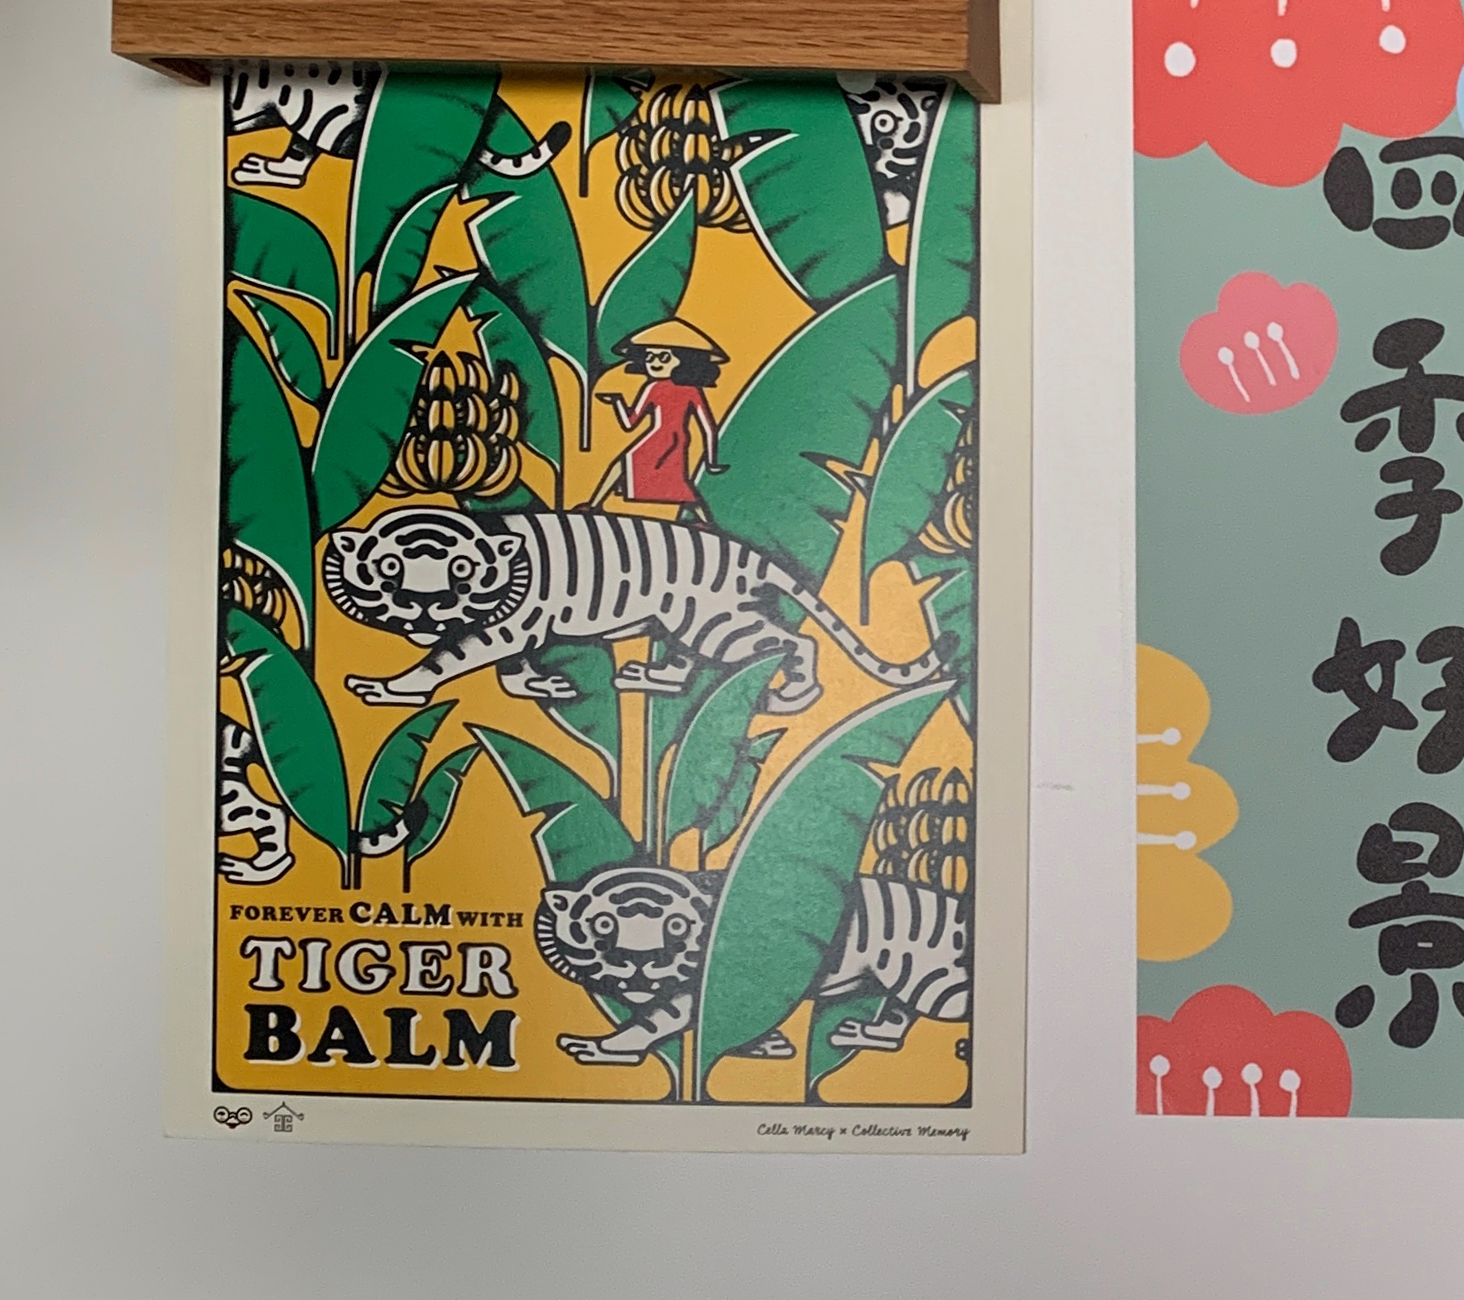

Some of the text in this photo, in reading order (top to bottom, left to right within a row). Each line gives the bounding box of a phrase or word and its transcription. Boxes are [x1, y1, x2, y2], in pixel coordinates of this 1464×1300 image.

[229, 901, 523, 928] FOREVER CALM WITH
[240, 935, 519, 999] TIGER
[244, 1003, 521, 1072] BALM
[852, 1124, 913, 1137] Collective
[917, 1126, 971, 1141] Memory
